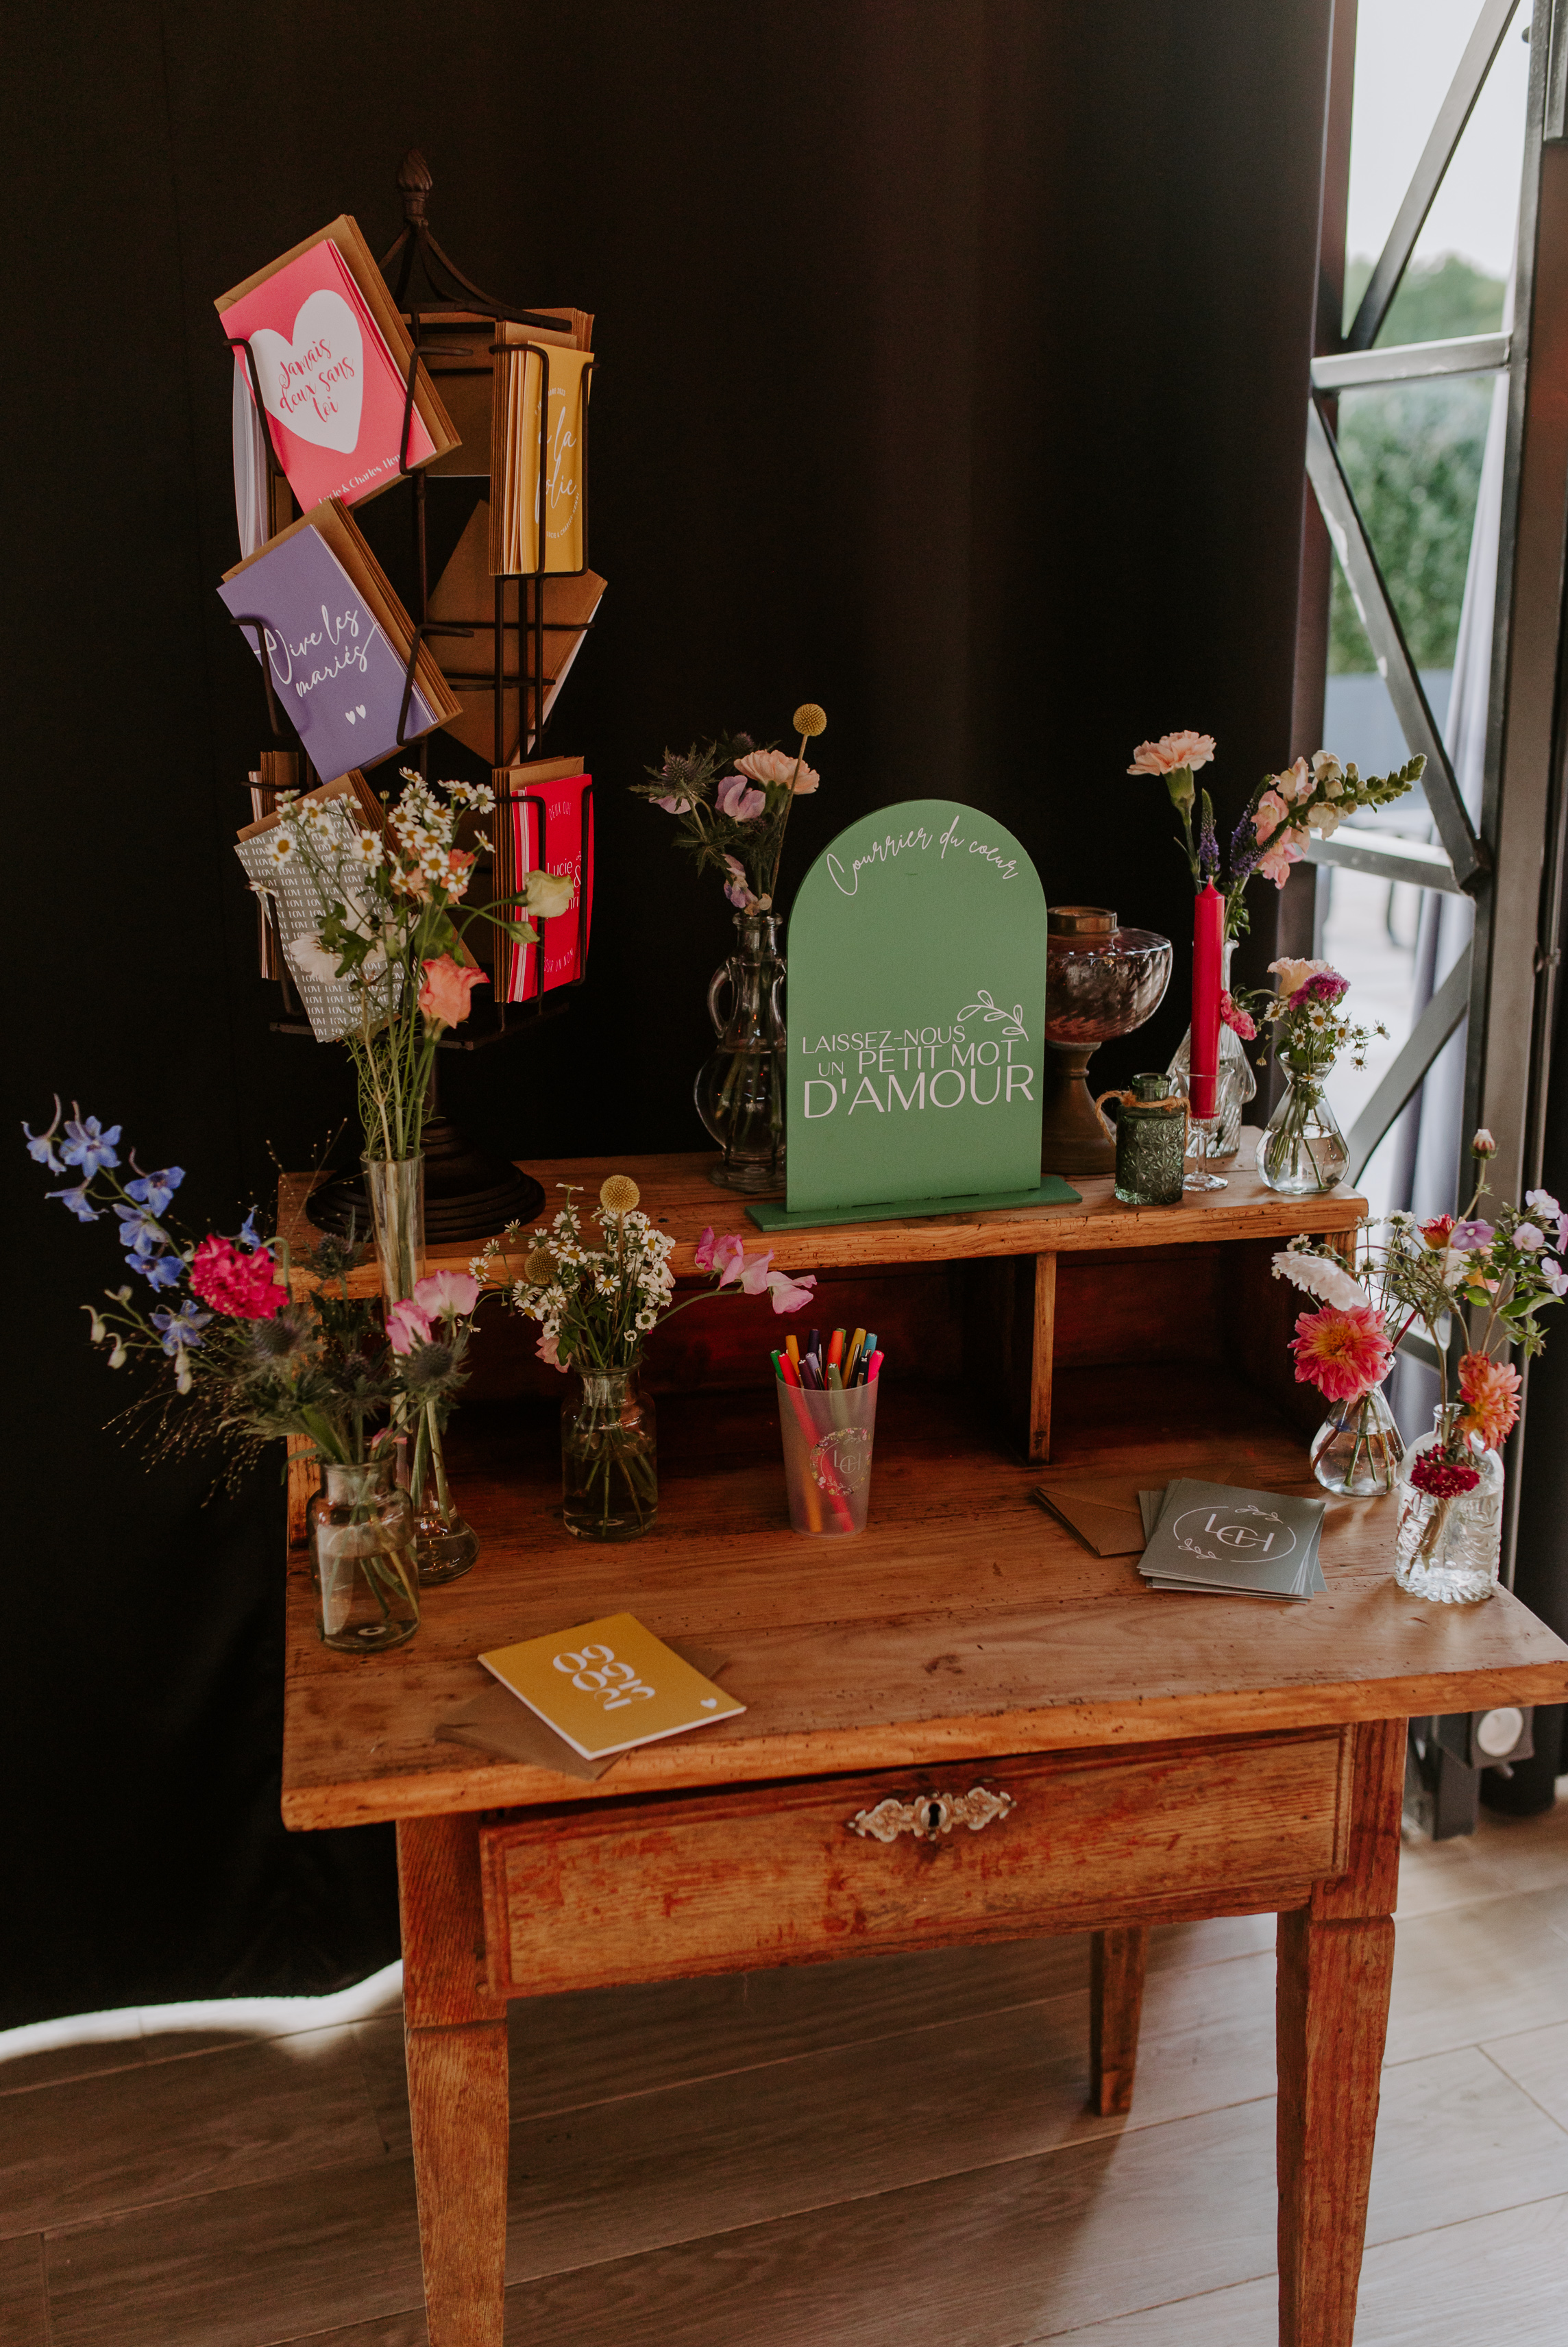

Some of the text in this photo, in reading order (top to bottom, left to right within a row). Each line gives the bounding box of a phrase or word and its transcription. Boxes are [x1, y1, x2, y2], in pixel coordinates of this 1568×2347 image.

[278, 339, 332, 389] Jamais
[280, 356, 355, 413] deux sans
[313, 396, 339, 423] toi
[553, 406, 577, 462] la
[253, 604, 359, 685] Vive les
[295, 622, 379, 698] mariés
[826, 826, 933, 896] Courrier
[939, 814, 965, 859] du
[802, 1025, 966, 1054] LAISSEZ-NOUS
[818, 1038, 1020, 1077] UN PETIT MOT
[804, 1064, 1035, 1119] D'AMOUR
[552, 1644, 615, 1673] 09
[572, 1662, 635, 1691] 09
[593, 1678, 656, 1711] 23
